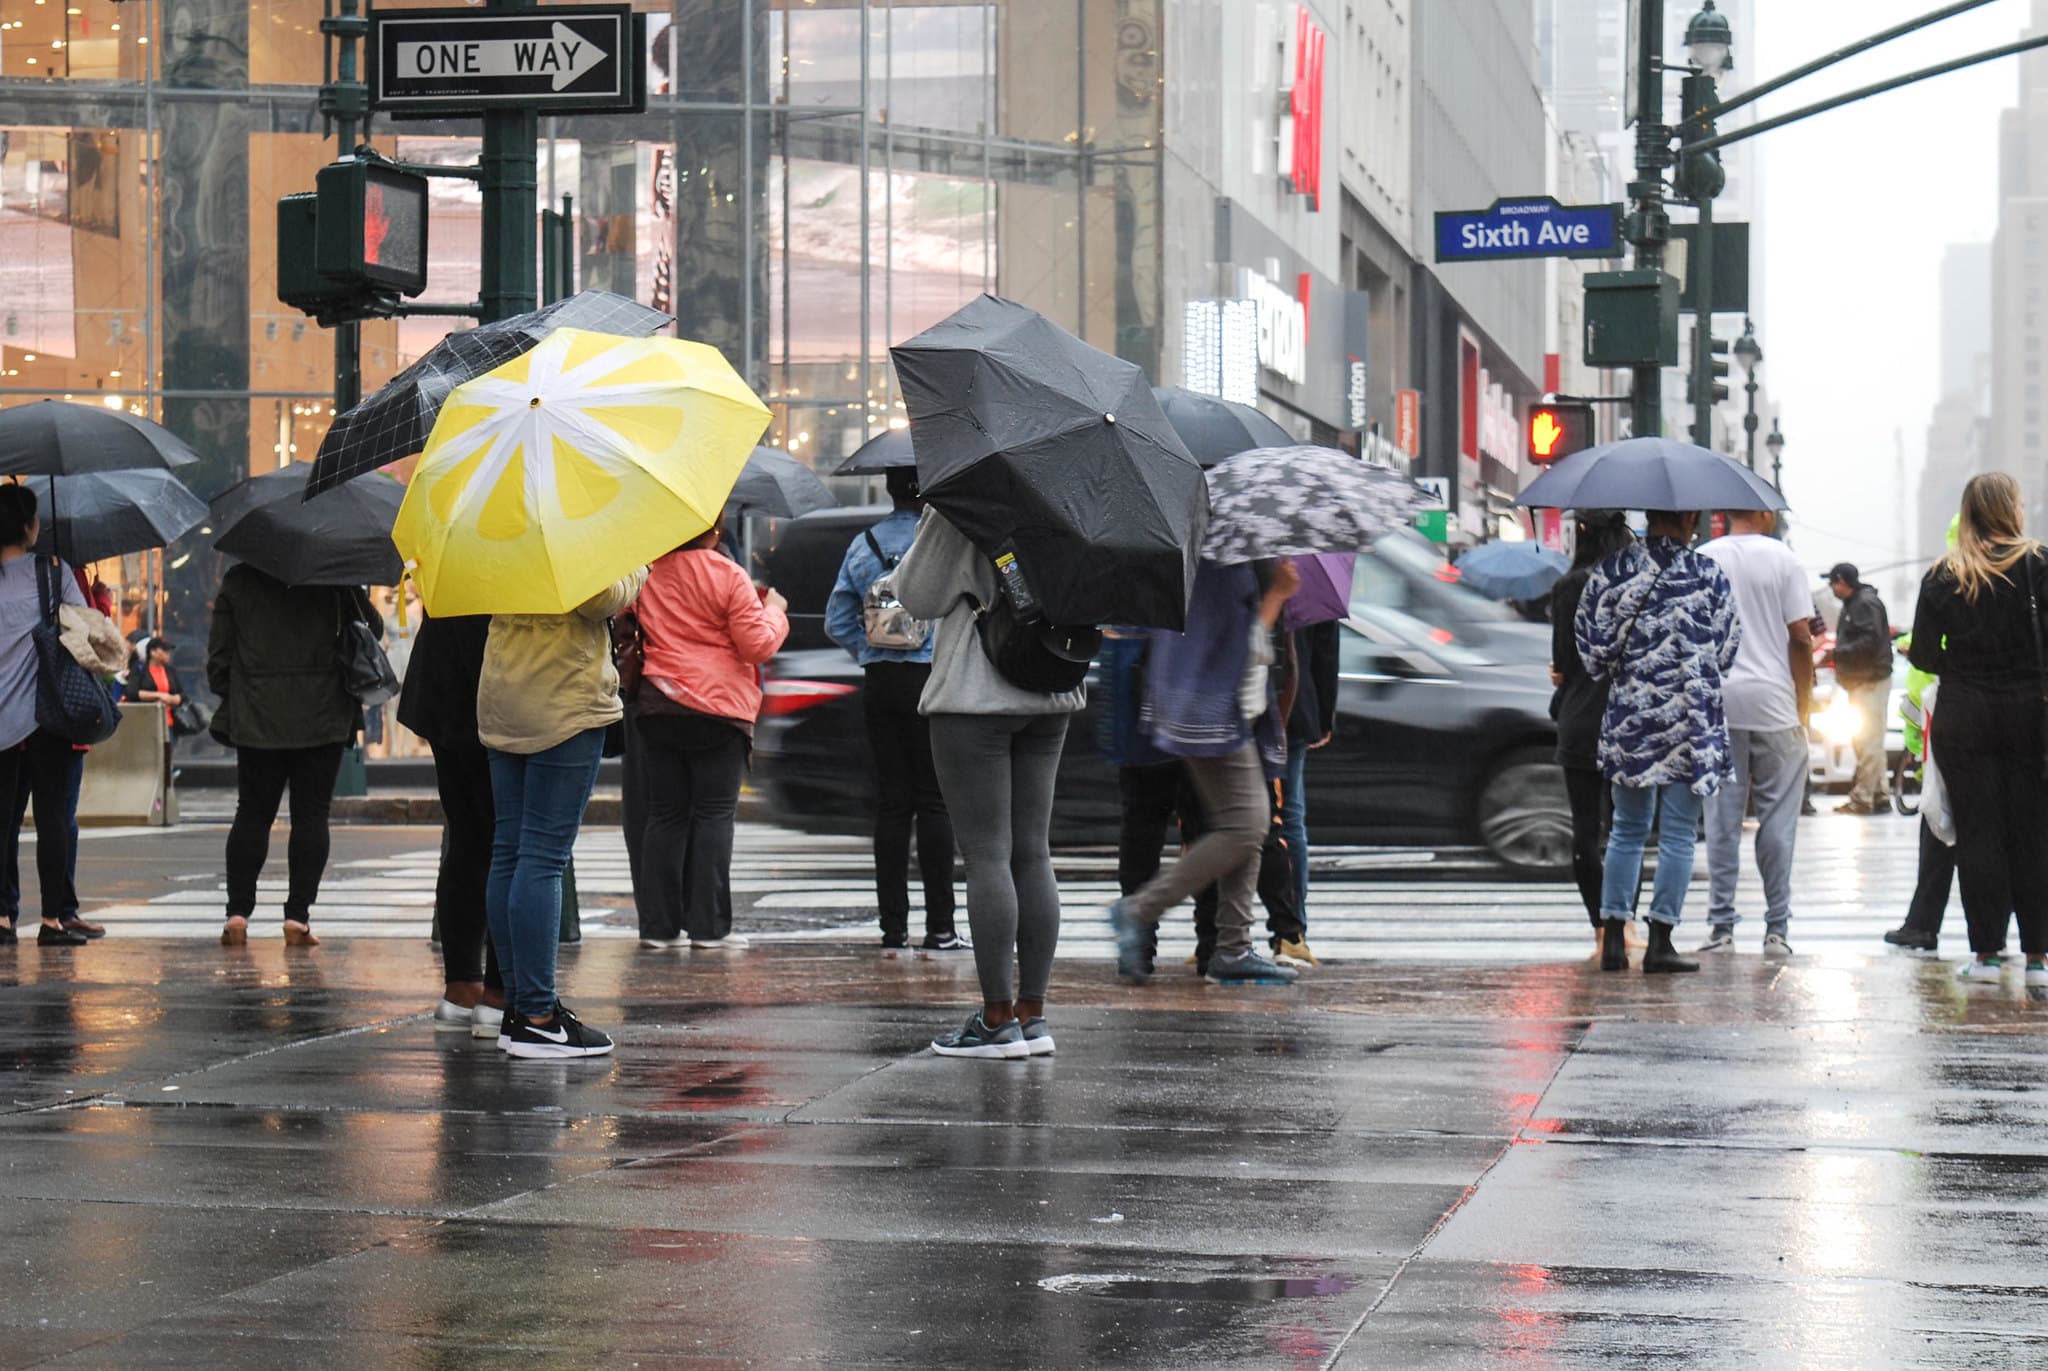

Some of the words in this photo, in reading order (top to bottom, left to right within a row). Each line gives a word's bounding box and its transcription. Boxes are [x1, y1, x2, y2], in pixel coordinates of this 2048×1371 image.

[415, 44, 481, 74] ONE
[514, 41, 582, 72] WAY
[1499, 204, 1550, 215] BROADWAY
[1461, 220, 1530, 249] Sixth
[1537, 220, 1590, 246] Ave
[1347, 361, 1366, 428] verizon
